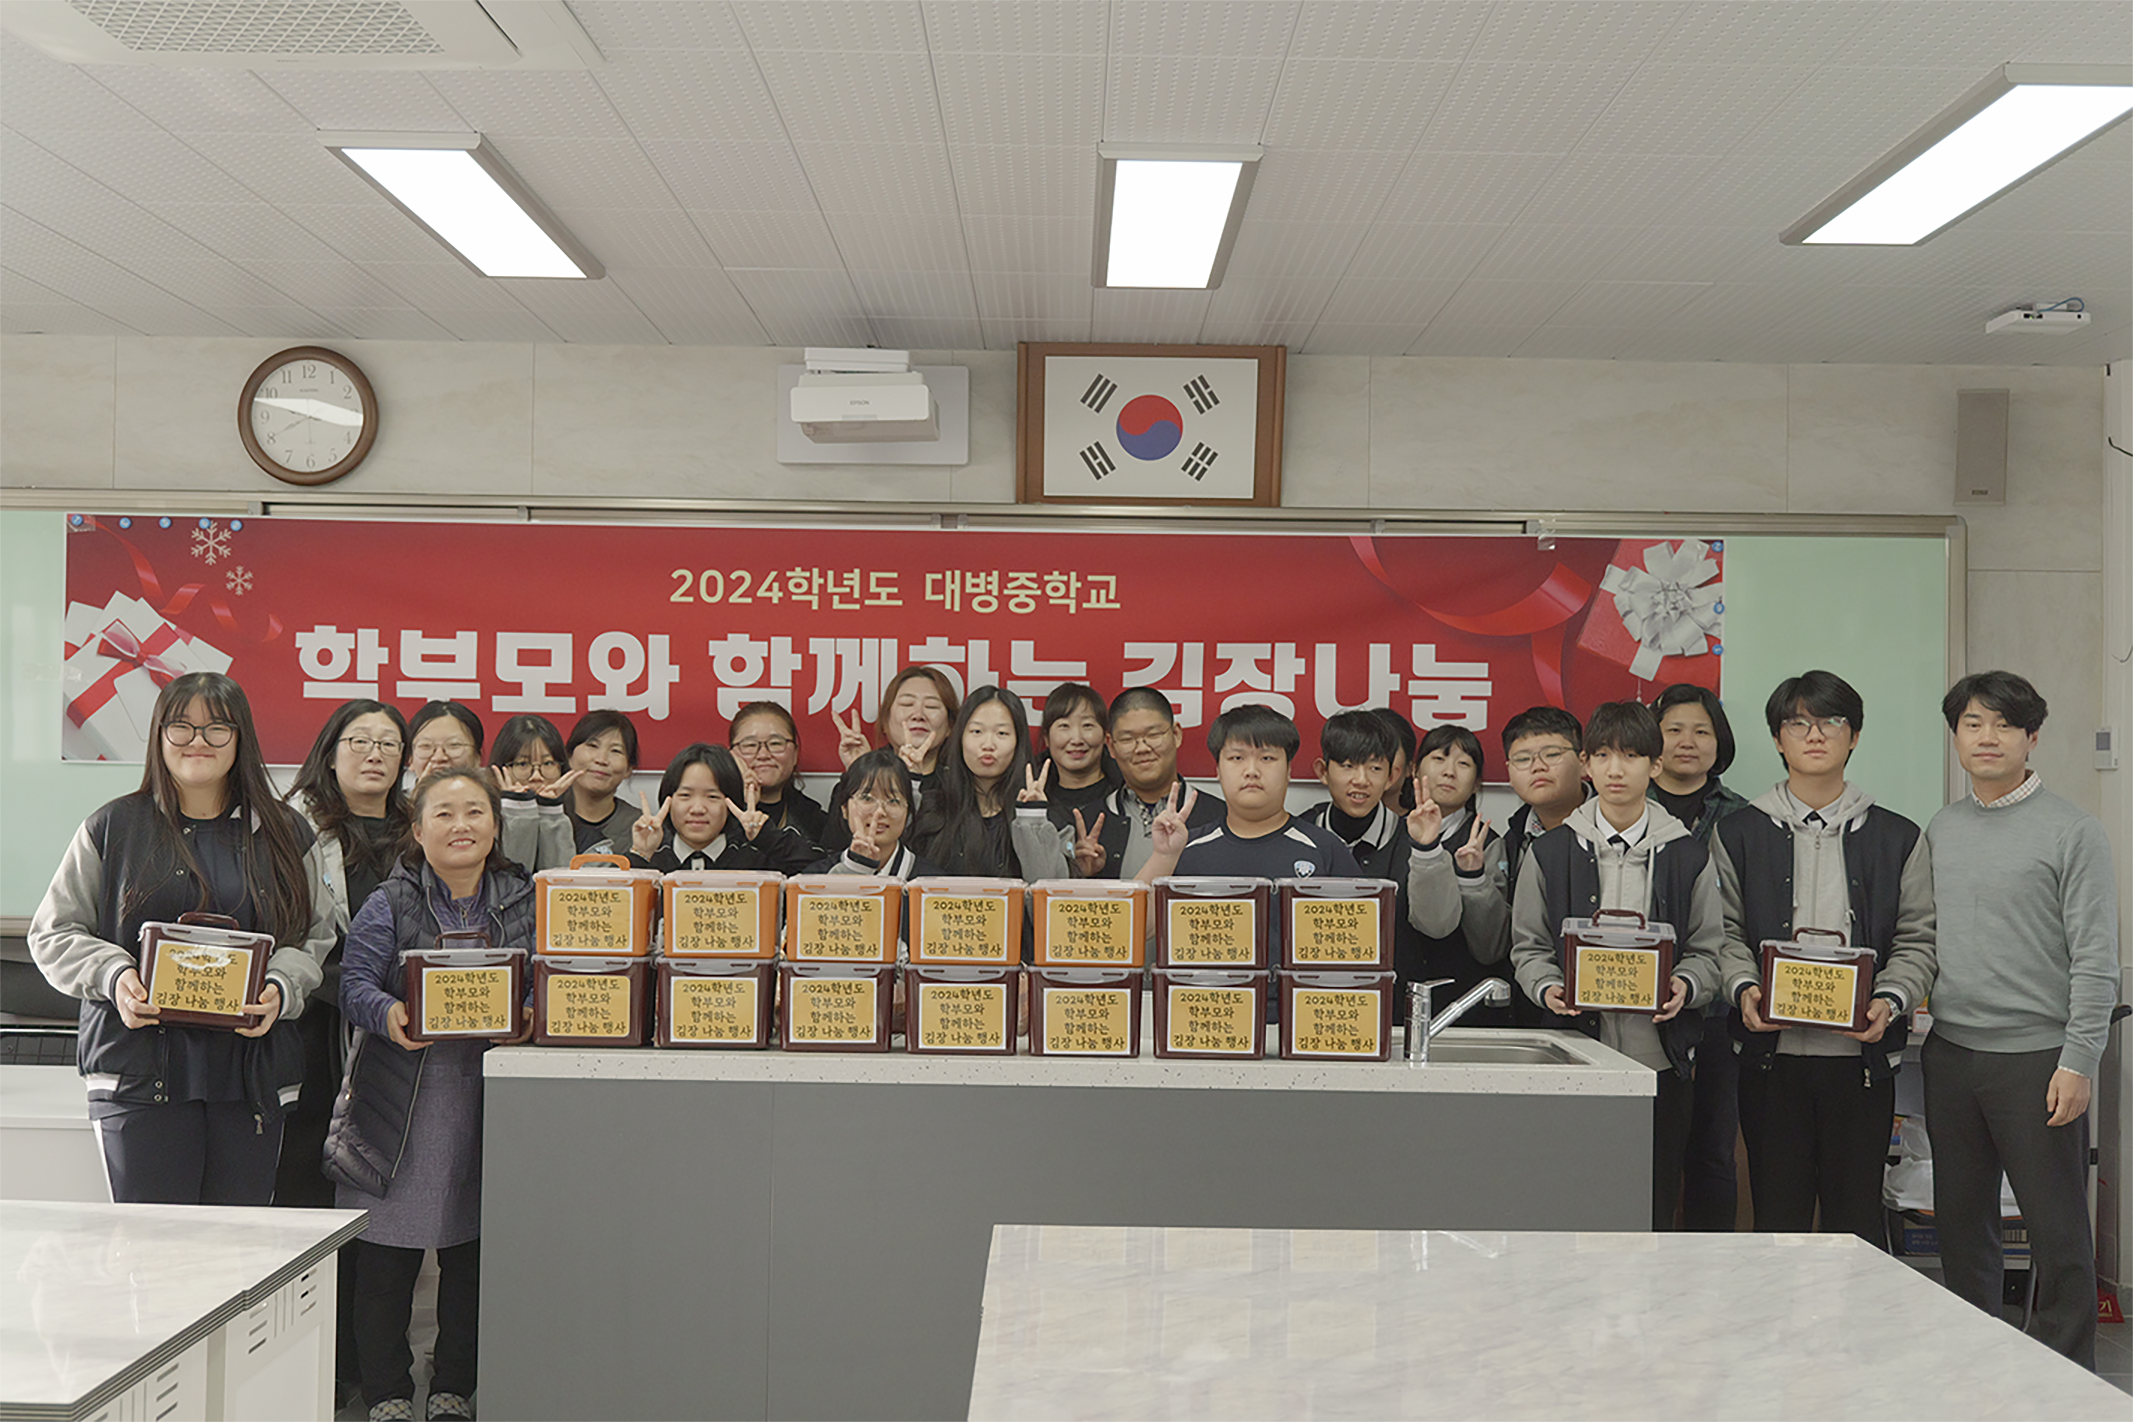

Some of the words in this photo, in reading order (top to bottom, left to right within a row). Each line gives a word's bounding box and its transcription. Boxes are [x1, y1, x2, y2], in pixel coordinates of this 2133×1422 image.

[281, 370, 292, 384] 11
[302, 365, 316, 379] 12
[329, 371, 335, 384] 1
[265, 387, 278, 400] 10
[343, 386, 352, 399] 2
[260, 411, 270, 424] 9
[266, 432, 276, 445] 8
[285, 450, 293, 464] 7
[306, 453, 316, 468] 6
[328, 448, 337, 462] 5
[670, 566, 903, 611] 2024학년도
[924, 570, 1121, 614] 대병중학교
[295, 625, 680, 720] 학부모와
[1122, 641, 1493, 732] 김장나눔
[559, 891, 621, 903] 2024학년도
[685, 892, 747, 905] 2024학년도
[810, 900, 872, 912] 2024학년도
[933, 899, 996, 912] 2024학년도
[1059, 902, 1121, 915] 2024학년도
[1180, 904, 1243, 917] 2024학년도
[1304, 903, 1367, 916] 2024학년도
[553, 934, 574, 946] 김장
[679, 935, 701, 948] 김장
[803, 942, 824, 954] 김장
[927, 942, 948, 954] 김장
[1053, 945, 1074, 957] 김장
[1175, 947, 1196, 960] 김장
[1299, 946, 1321, 959] 김장
[435, 972, 499, 984] 2024학년도
[558, 978, 620, 991] 2024학년도
[683, 982, 745, 995] 2024학년도
[802, 982, 864, 995] 2024학년도
[931, 989, 993, 1001] 2024학년도
[156, 991, 181, 1006] 김장
[1056, 994, 1118, 1006] 2024학년도
[1181, 992, 1243, 1005] 2024학년도
[1305, 994, 1368, 1007] 2024학년도
[429, 1016, 451, 1029] 김장
[552, 1021, 573, 1033] 김장
[677, 1024, 698, 1037] 김장
[797, 1025, 818, 1037] 김장
[926, 1031, 947, 1044] 김장
[1050, 1036, 1071, 1049] 김장
[1174, 1034, 1195, 1047] 김장
[1299, 1037, 1320, 1049] 김장
